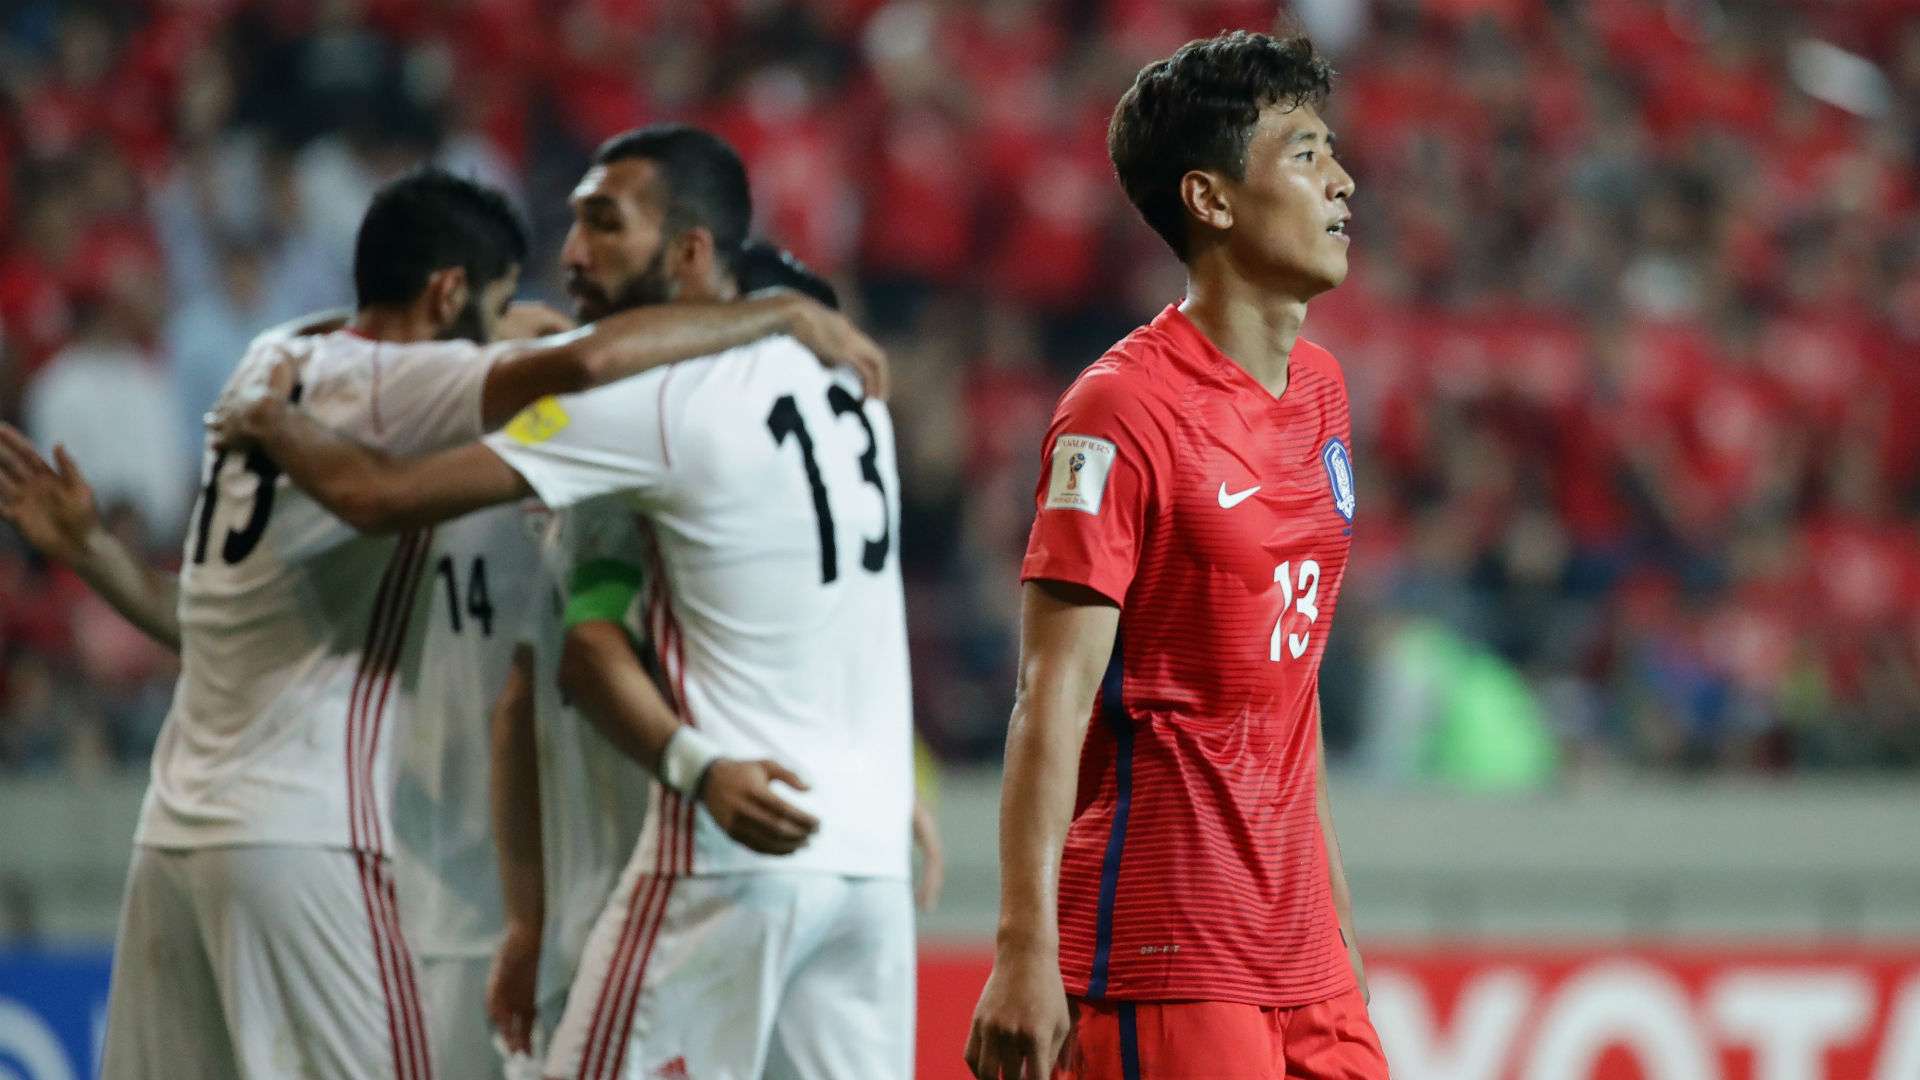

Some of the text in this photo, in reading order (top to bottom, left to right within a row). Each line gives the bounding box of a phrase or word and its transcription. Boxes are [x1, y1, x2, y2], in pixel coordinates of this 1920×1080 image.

[767, 384, 890, 584] 13
[437, 554, 494, 637] 14
[1269, 559, 1321, 662] 13
[1369, 957, 1920, 1080] YOT
